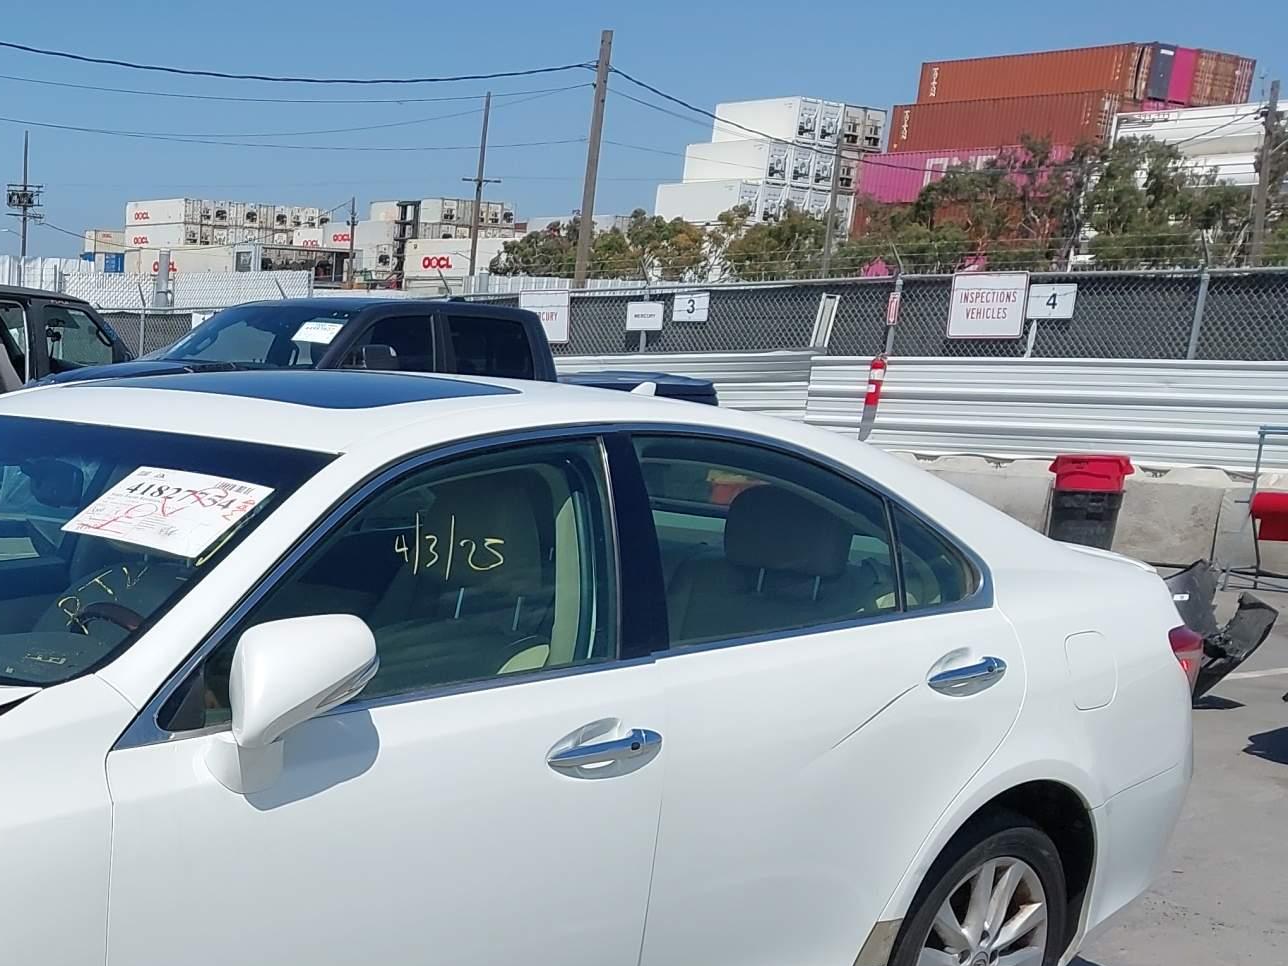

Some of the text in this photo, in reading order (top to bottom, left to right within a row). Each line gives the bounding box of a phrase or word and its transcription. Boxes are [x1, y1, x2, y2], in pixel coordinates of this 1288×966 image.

[152, 261, 177, 272] OCL
[422, 256, 452, 269] OOCL
[959, 290, 1017, 304] INSPECTIONS
[1045, 292, 1058, 310] 4
[686, 299, 696, 314] 3
[964, 307, 1008, 320] VEHICLES
[395, 512, 505, 580] 4/3/25
